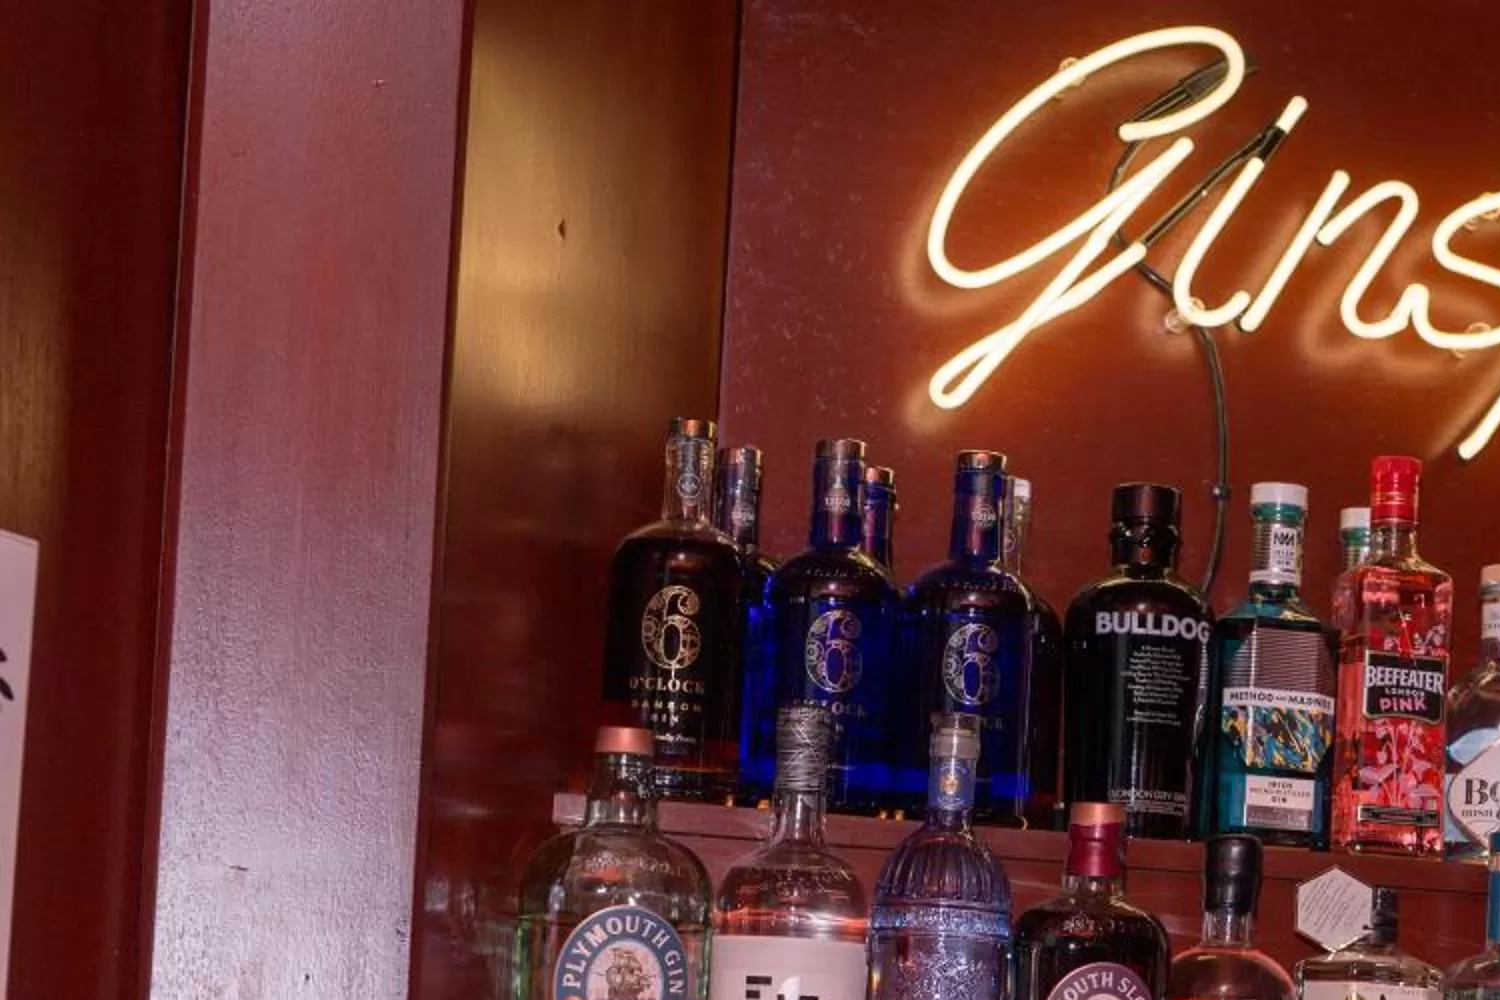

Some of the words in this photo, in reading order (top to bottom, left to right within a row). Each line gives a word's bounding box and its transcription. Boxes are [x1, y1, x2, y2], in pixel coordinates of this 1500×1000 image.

[1095, 611, 1213, 645] BULLDOG
[1365, 664, 1443, 698] BEEFEATER
[1384, 688, 1425, 698] LONDON
[1379, 699, 1426, 713] PINK
[560, 914, 670, 990] PLYMOUTH
[662, 949, 686, 995] GIN
